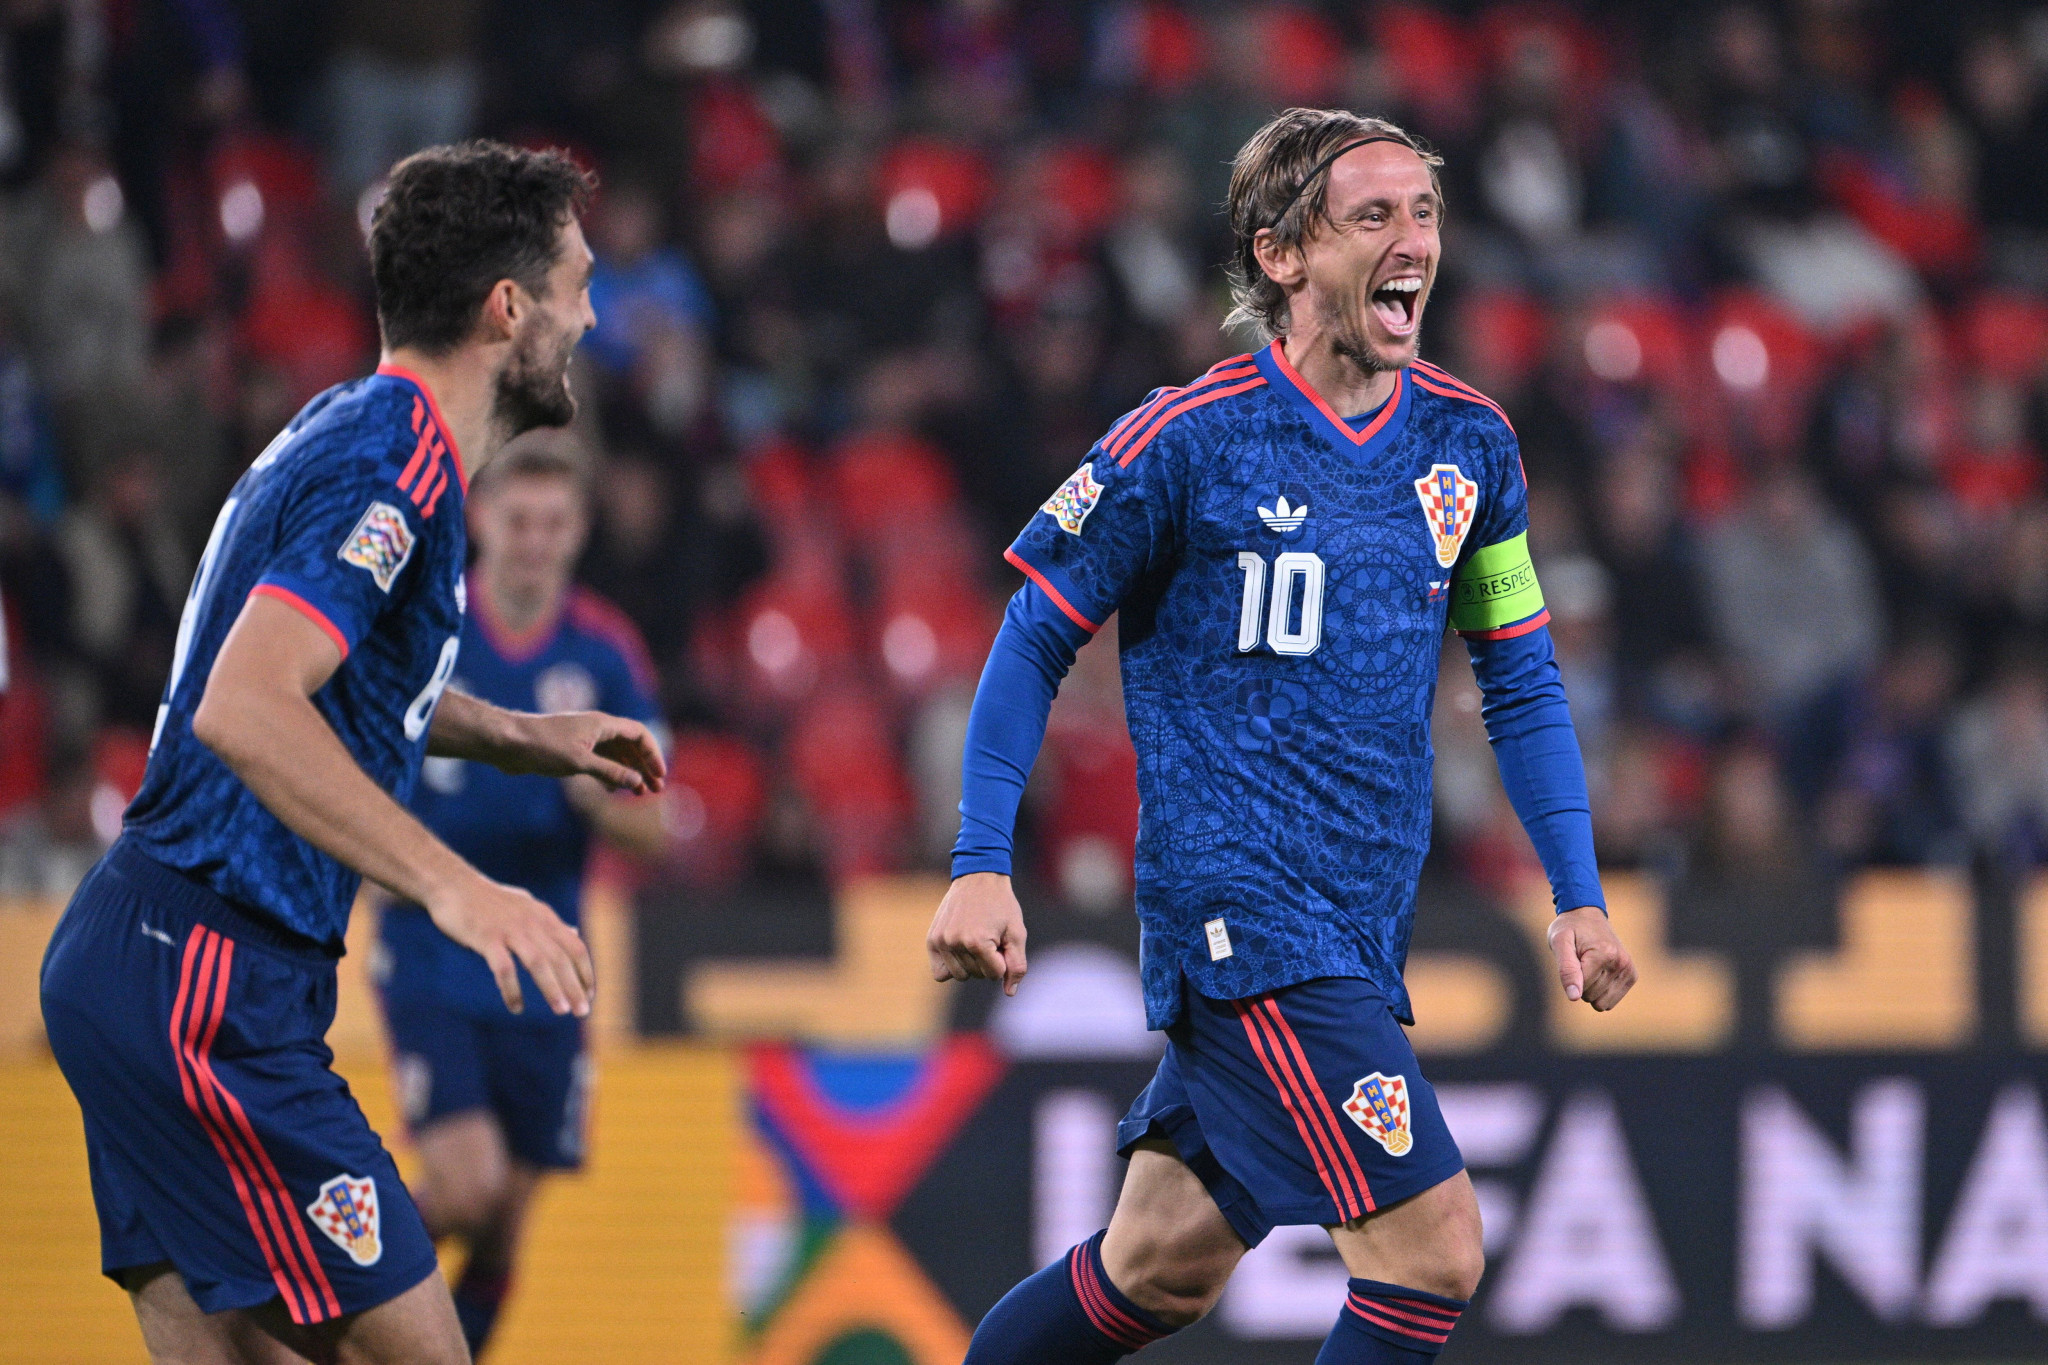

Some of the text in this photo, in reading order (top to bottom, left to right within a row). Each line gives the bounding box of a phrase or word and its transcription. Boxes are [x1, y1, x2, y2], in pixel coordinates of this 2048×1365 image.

[1442, 476, 1455, 526] HNS
[1479, 566, 1533, 597] RESPECT
[1238, 551, 1326, 657] 10
[1367, 1086, 1391, 1124] HNS
